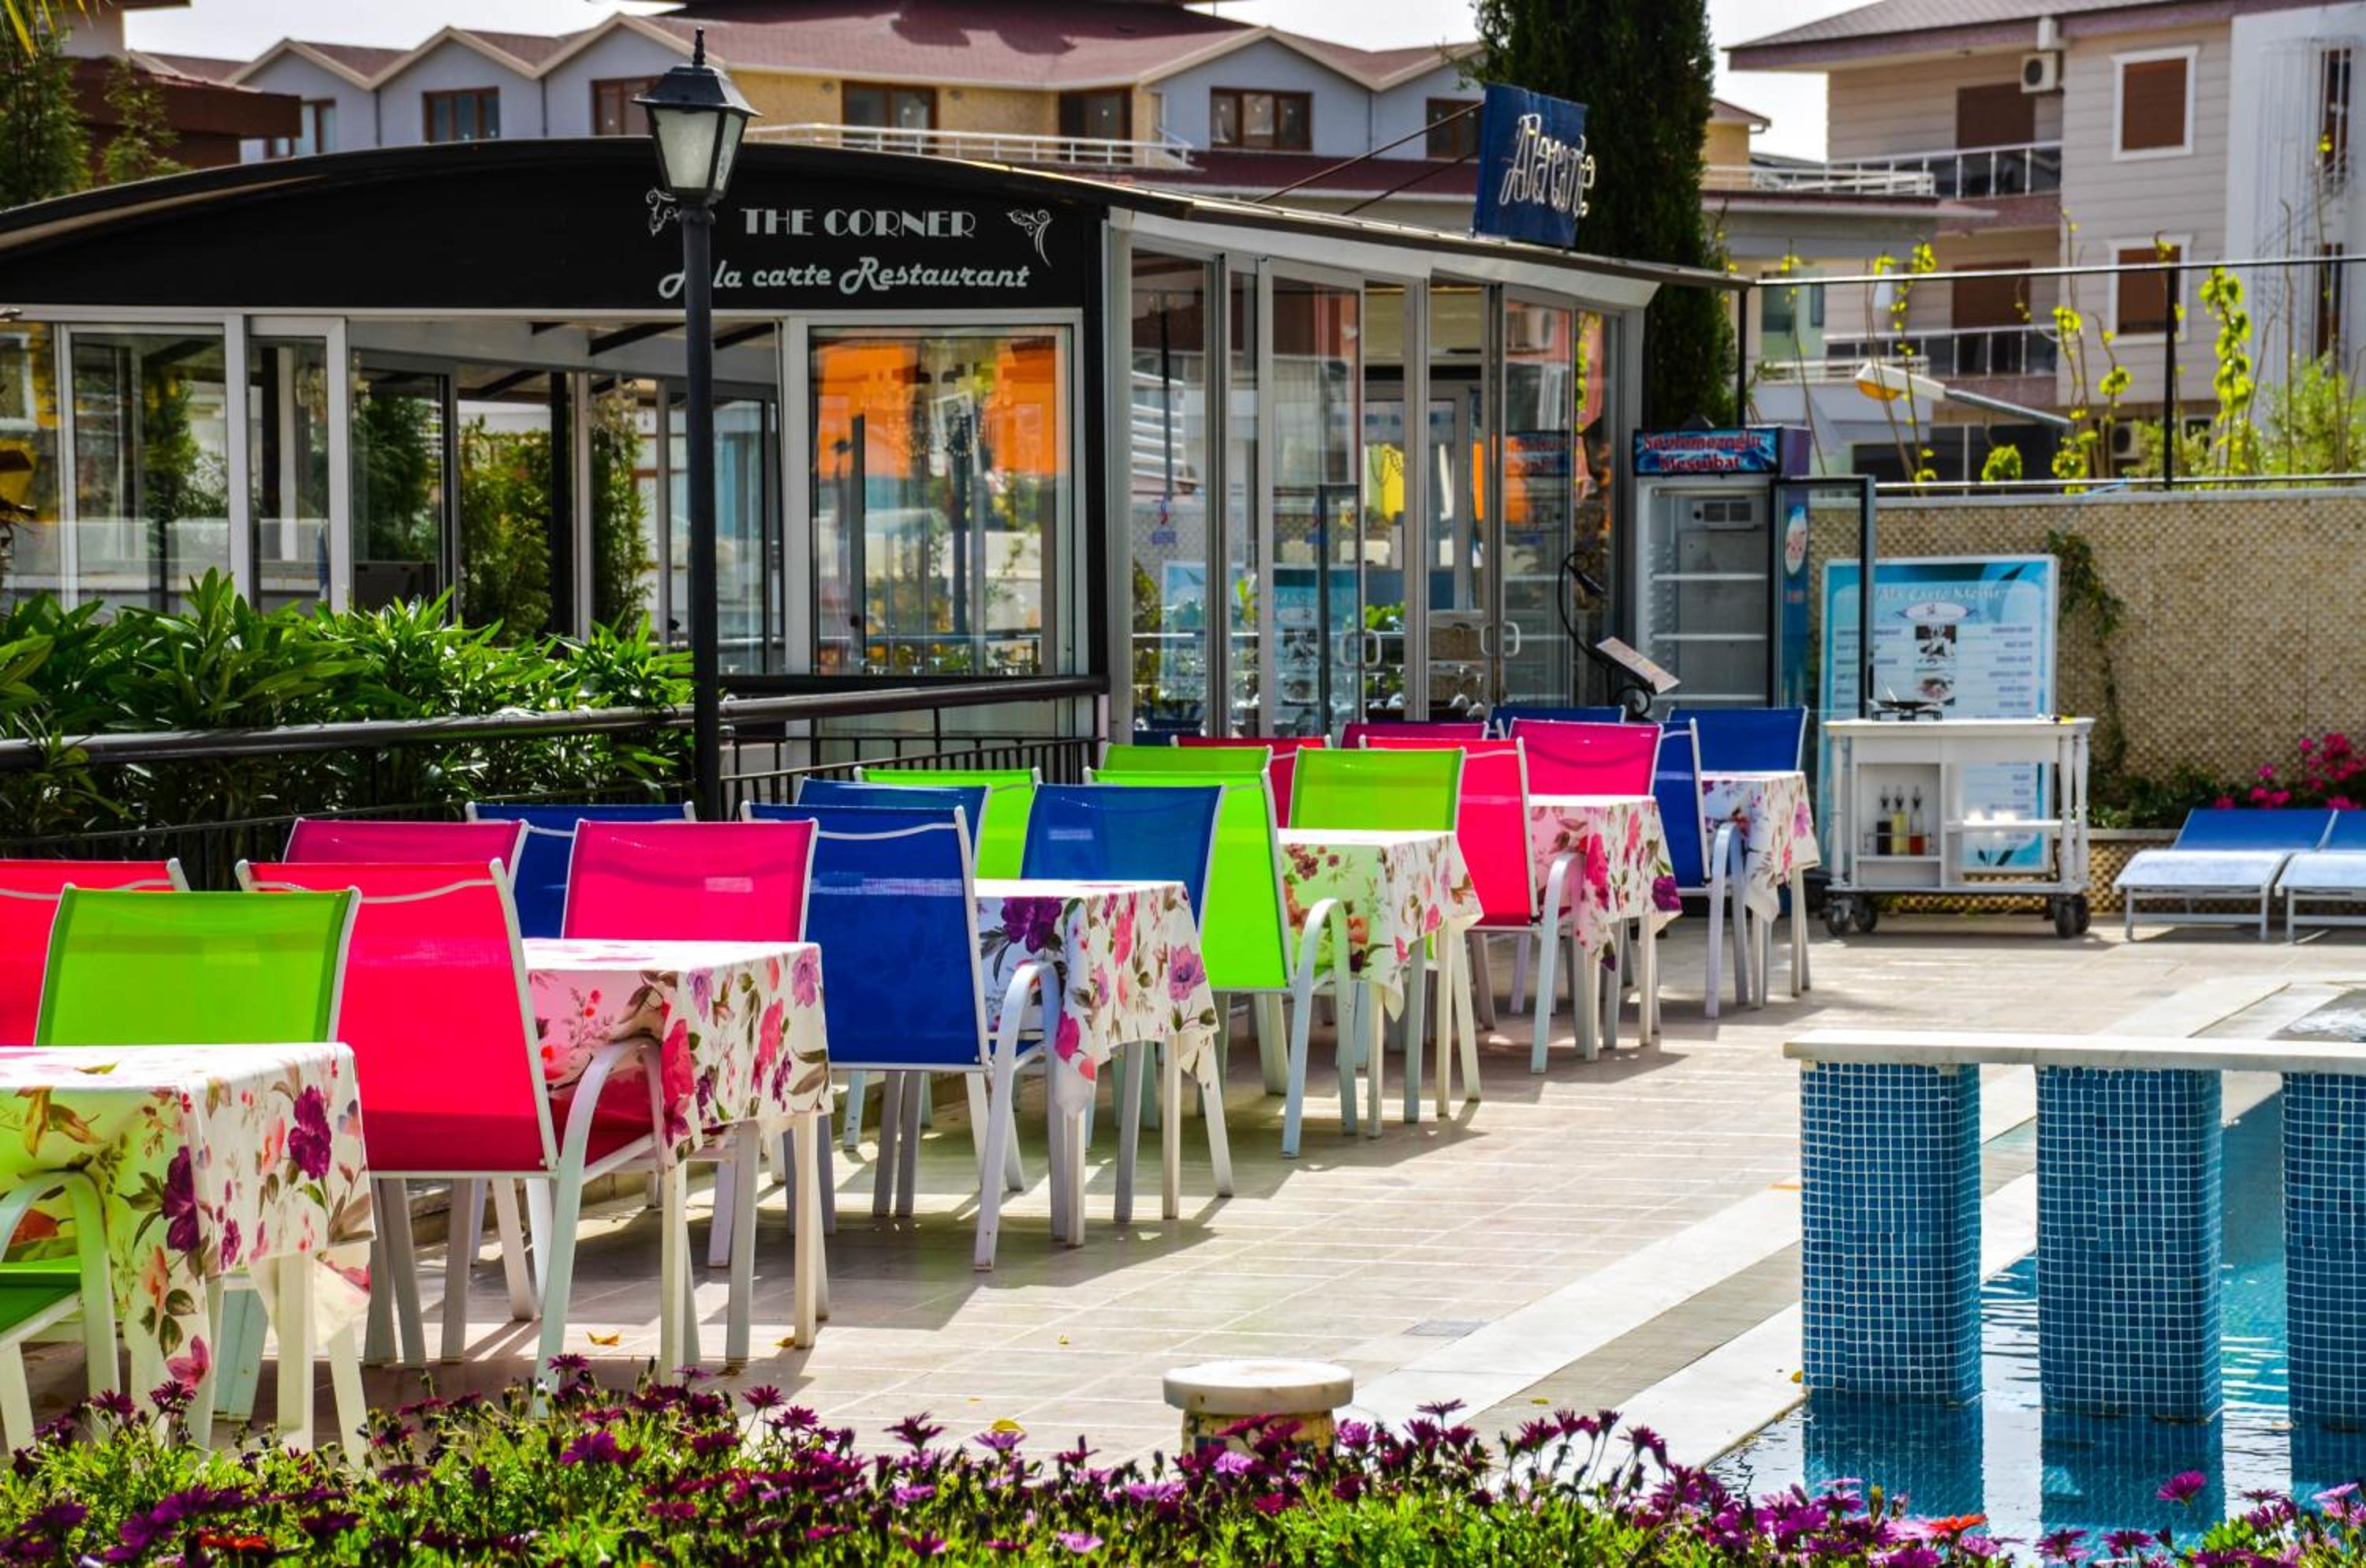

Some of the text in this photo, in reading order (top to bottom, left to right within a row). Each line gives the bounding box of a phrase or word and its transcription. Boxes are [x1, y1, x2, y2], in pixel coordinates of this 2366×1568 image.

[740, 208, 976, 238] THE CORNER
[713, 259, 743, 289] la
[752, 263, 832, 287] carte
[839, 256, 1029, 295] Restaurant
